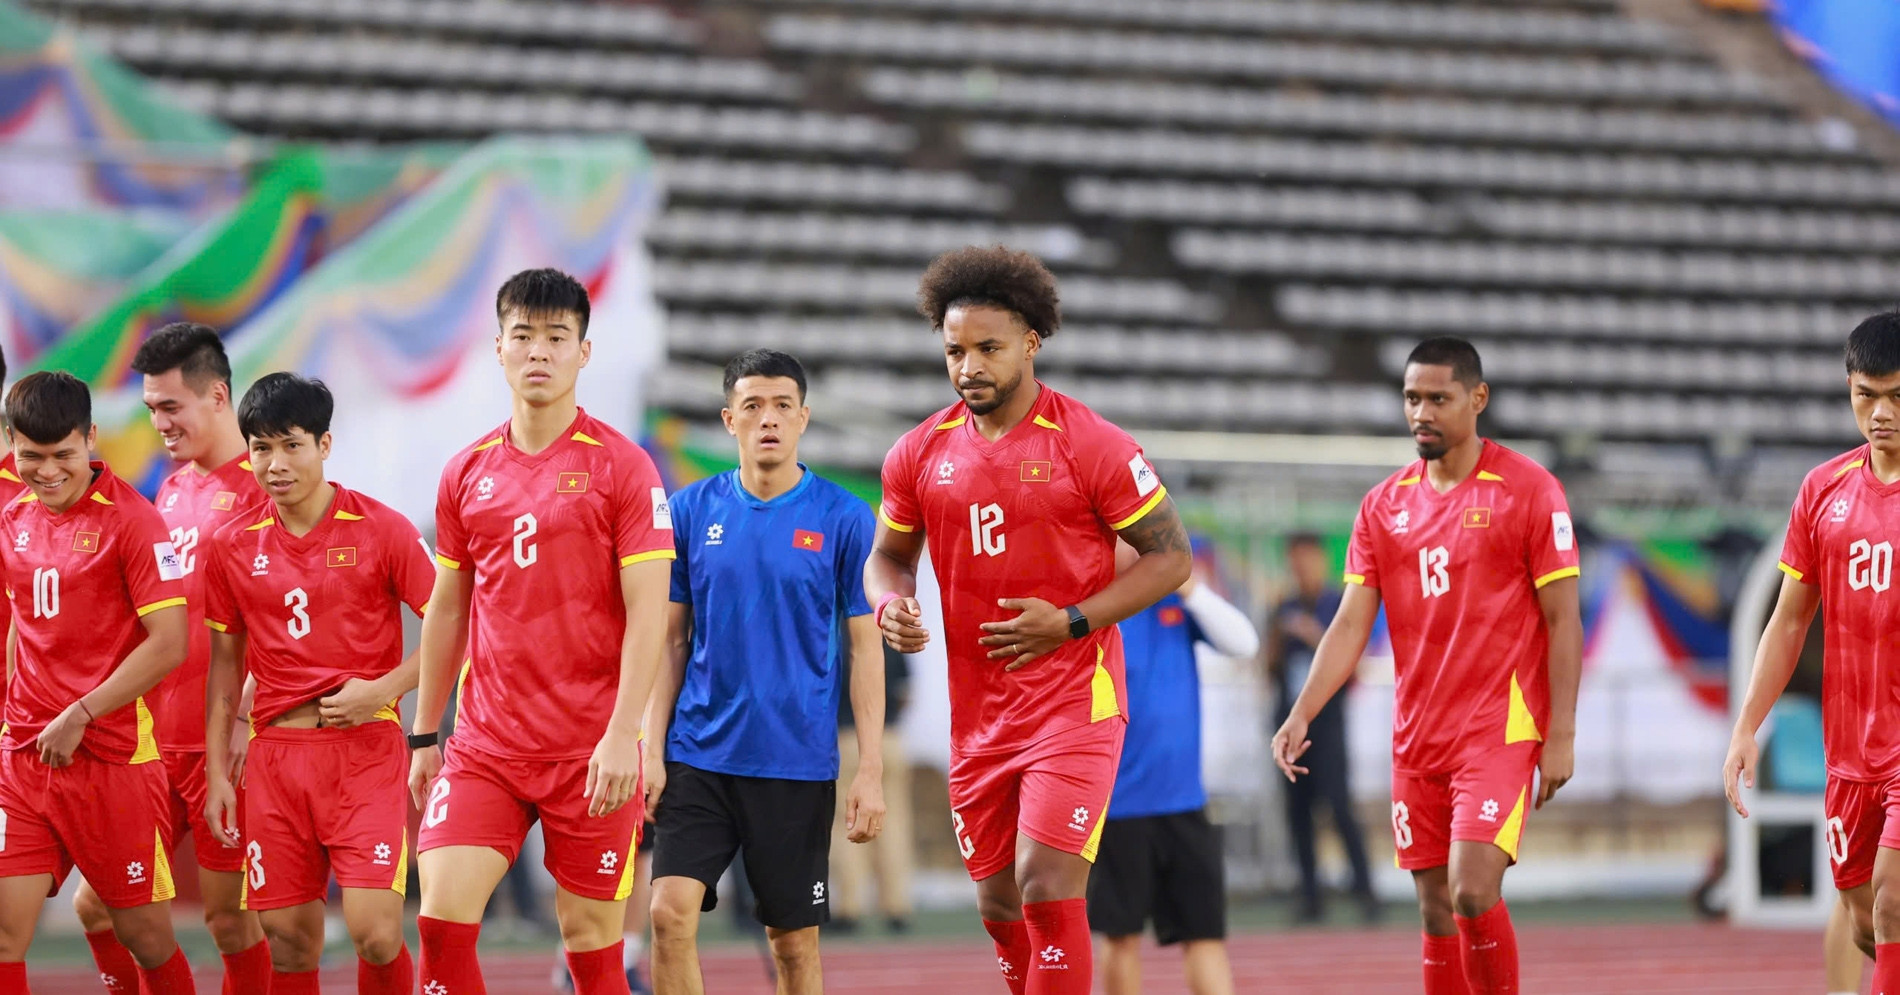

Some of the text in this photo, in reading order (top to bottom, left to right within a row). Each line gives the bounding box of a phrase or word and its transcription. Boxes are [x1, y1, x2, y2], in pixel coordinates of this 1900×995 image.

[513, 512, 537, 569] 2
[969, 502, 1006, 557] 12
[1419, 545, 1450, 599] 13
[1848, 538, 1893, 594] 20
[33, 567, 60, 619] 10
[284, 587, 311, 640] 3
[425, 776, 451, 829] 2
[247, 840, 266, 891] 3
